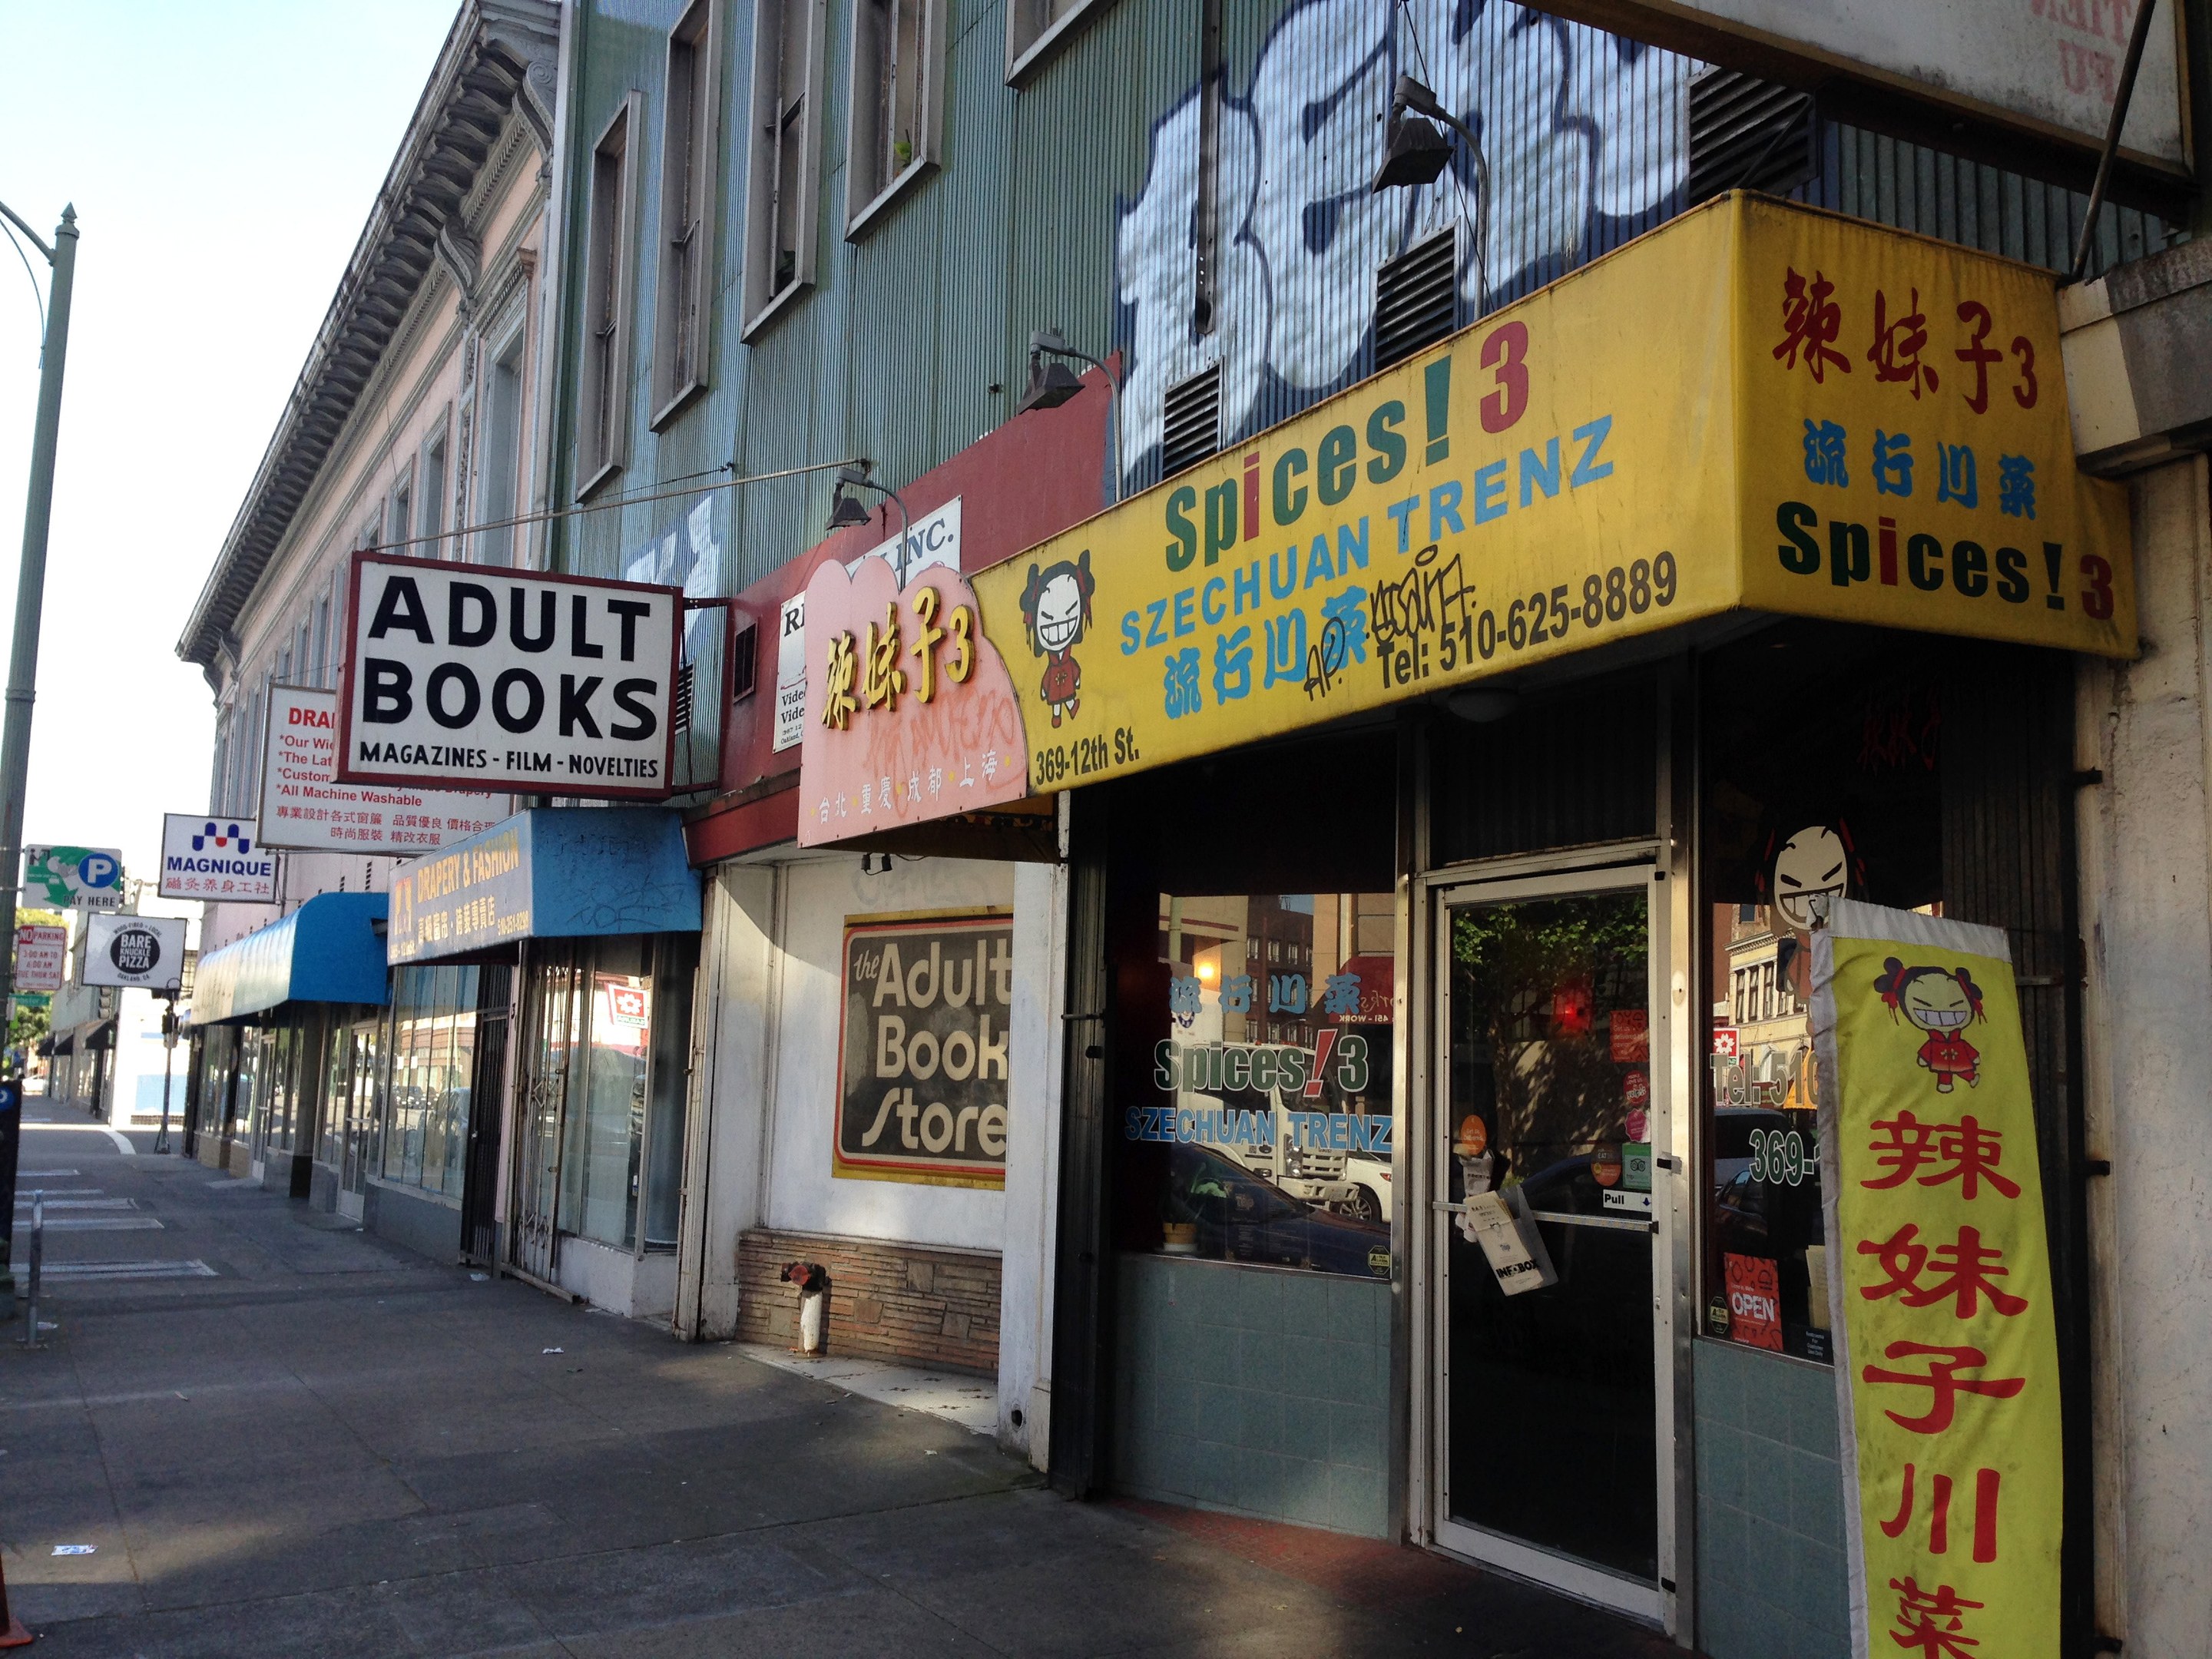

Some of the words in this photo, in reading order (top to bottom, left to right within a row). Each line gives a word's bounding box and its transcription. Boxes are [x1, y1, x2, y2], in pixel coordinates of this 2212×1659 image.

[1165, 355, 1452, 572] Spices!
[1479, 320, 1529, 433] 3
[896, 518, 954, 571] INC.
[1120, 516, 1369, 657] SZECHUAN
[1387, 415, 1614, 553] TRENZ
[1776, 502, 2065, 611] Spices!
[2080, 554, 2115, 621] 3
[367, 575, 651, 662] ADULT
[1376, 632, 1429, 688] Tel:
[1439, 550, 1678, 672] 510-625-8889
[363, 657, 657, 741] BOOKS
[360, 741, 487, 769] MAGAZINES
[506, 750, 551, 773] FILM
[569, 754, 658, 778] NOVELTIES
[1035, 731, 1108, 786] 369-12th
[1114, 727, 1141, 767] St.
[303, 786, 356, 802] Machine
[362, 791, 422, 806] Washable
[88, 858, 111, 883] P
[167, 856, 271, 876] MAGNIQUE
[417, 853, 460, 904] DRAPERY
[462, 848, 472, 885] &
[473, 826, 520, 879] FASHION
[64, 896, 83, 906] PAY
[88, 896, 116, 907] HERE
[19, 929, 32, 941] NO
[33, 931, 64, 941] PARKING
[120, 947, 151, 956] KNUCKLE
[121, 934, 152, 949] BARE
[118, 955, 150, 969] PIZZA
[853, 949, 880, 982] the
[873, 938, 1012, 1008] Adult
[876, 1014, 1008, 1081] Book
[1154, 1028, 1337, 1098] Spices!
[1337, 1035, 1369, 1092] 3
[1710, 1051, 1761, 1104] Tel:
[861, 1088, 1007, 1157] Store
[1124, 1106, 1277, 1146] SZECHUAN
[1288, 1111, 1392, 1153] TRENZ
[1749, 1128, 1820, 1186] 369-
[1604, 1193, 1625, 1207] Pull
[1732, 1292, 1774, 1322] OPEN
